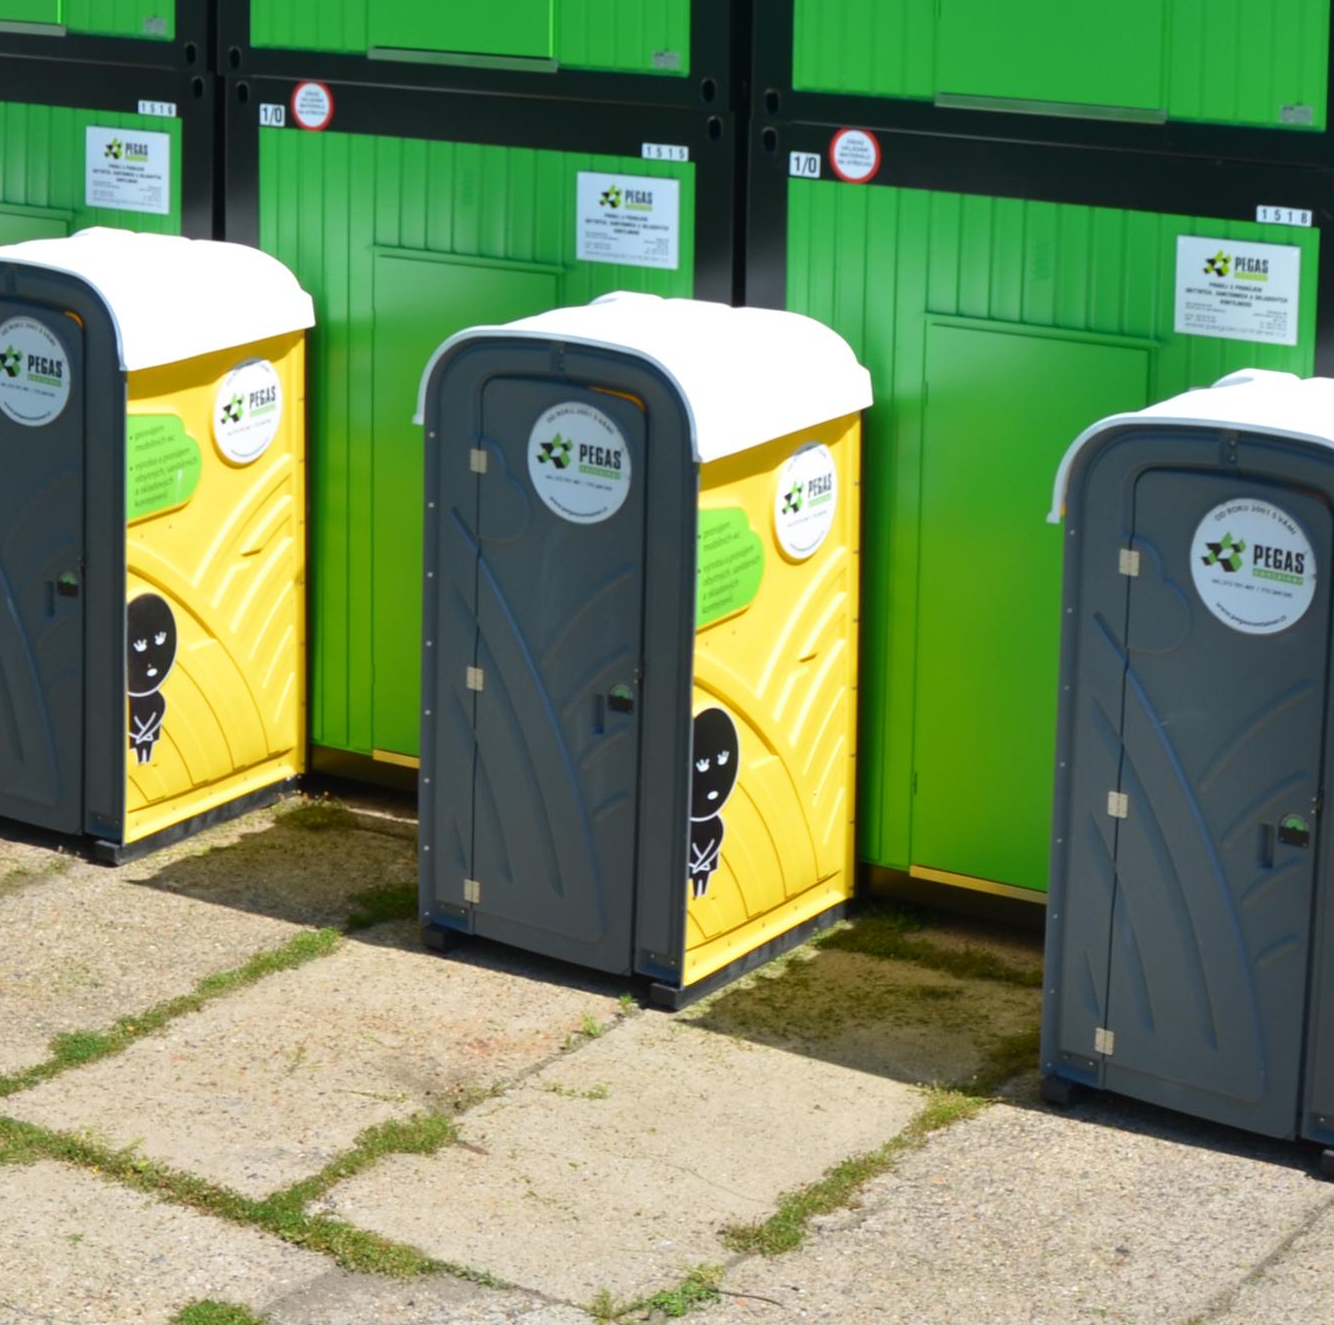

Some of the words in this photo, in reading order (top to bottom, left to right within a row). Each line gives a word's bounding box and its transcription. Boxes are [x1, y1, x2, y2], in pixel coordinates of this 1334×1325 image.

[262, 105, 283, 125] 1/0
[125, 142, 149, 156] PEGAS
[794, 155, 816, 176] 1/0
[624, 189, 653, 205] PEGAS
[1234, 256, 1269, 274] PEGAS
[28, 354, 63, 378] PEGAS
[249, 385, 276, 409] PEGAS
[578, 443, 622, 470] PEGAS
[808, 473, 833, 498] PEGAS
[1252, 544, 1305, 575] PEGAS
